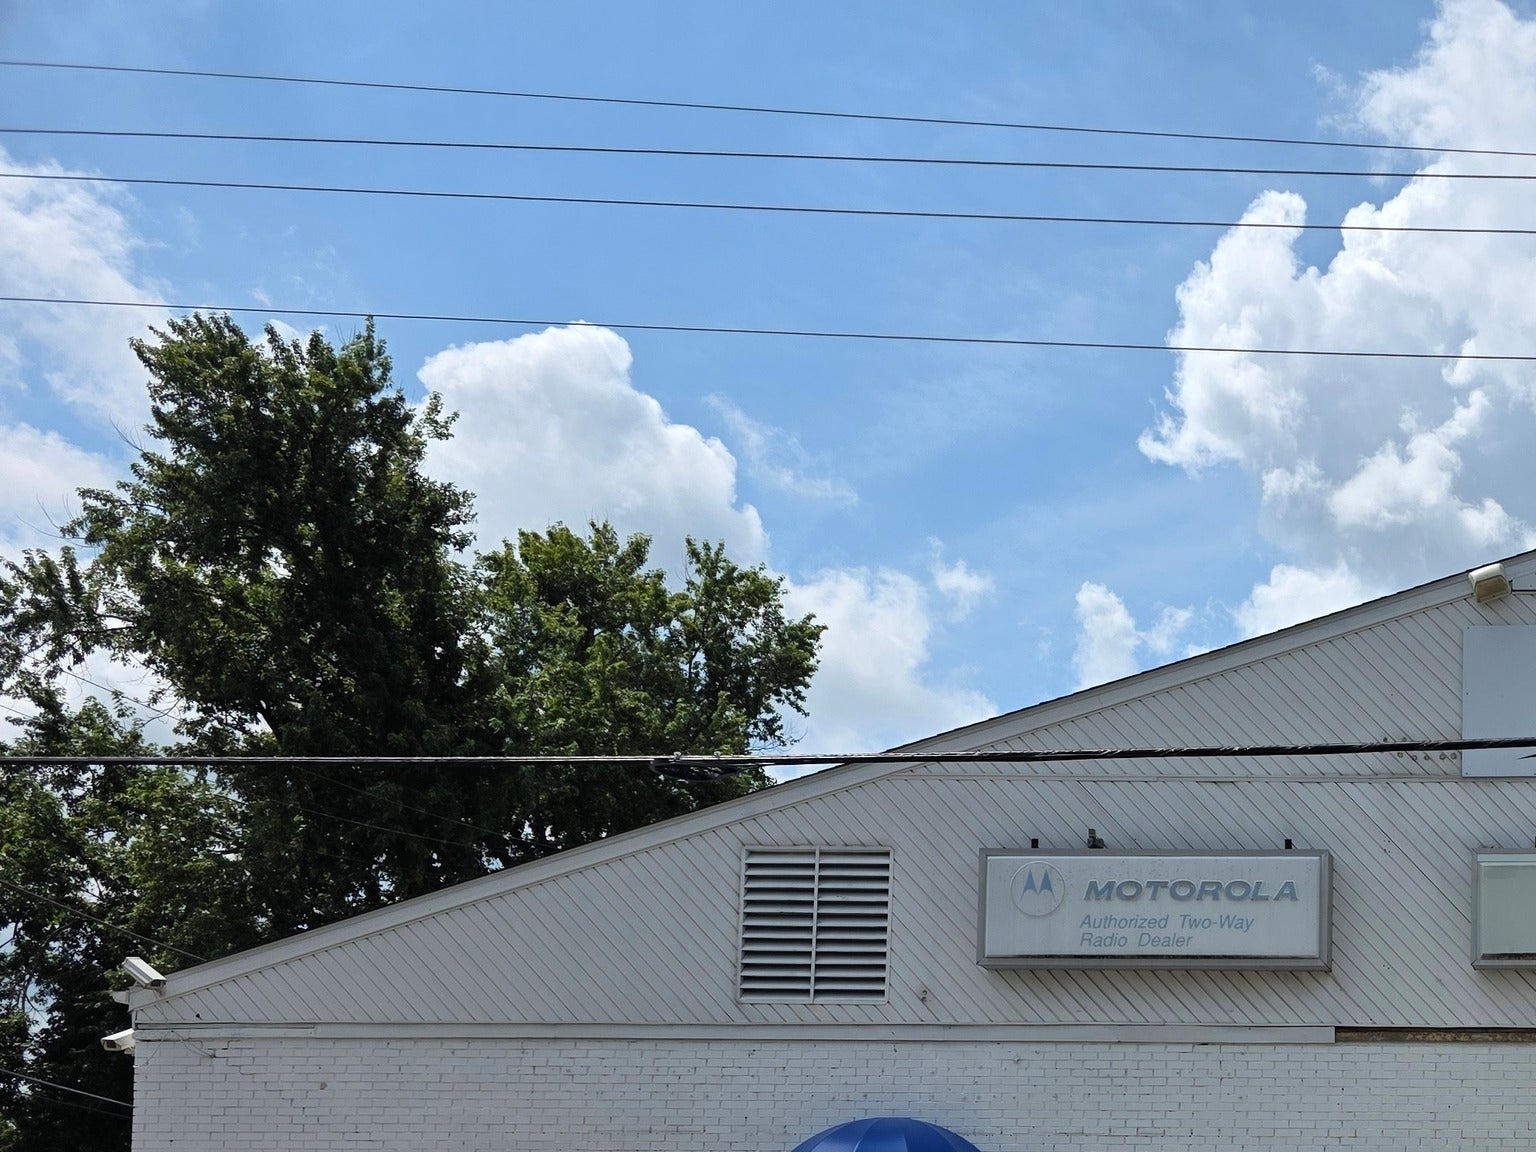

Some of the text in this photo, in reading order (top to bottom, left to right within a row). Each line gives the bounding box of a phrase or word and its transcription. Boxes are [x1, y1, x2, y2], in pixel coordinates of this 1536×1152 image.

[1083, 879, 1299, 902] MOTOROLA
[1079, 914, 1255, 933] Authorized Two-Way
[1079, 932, 1194, 948] Radio Dealer
